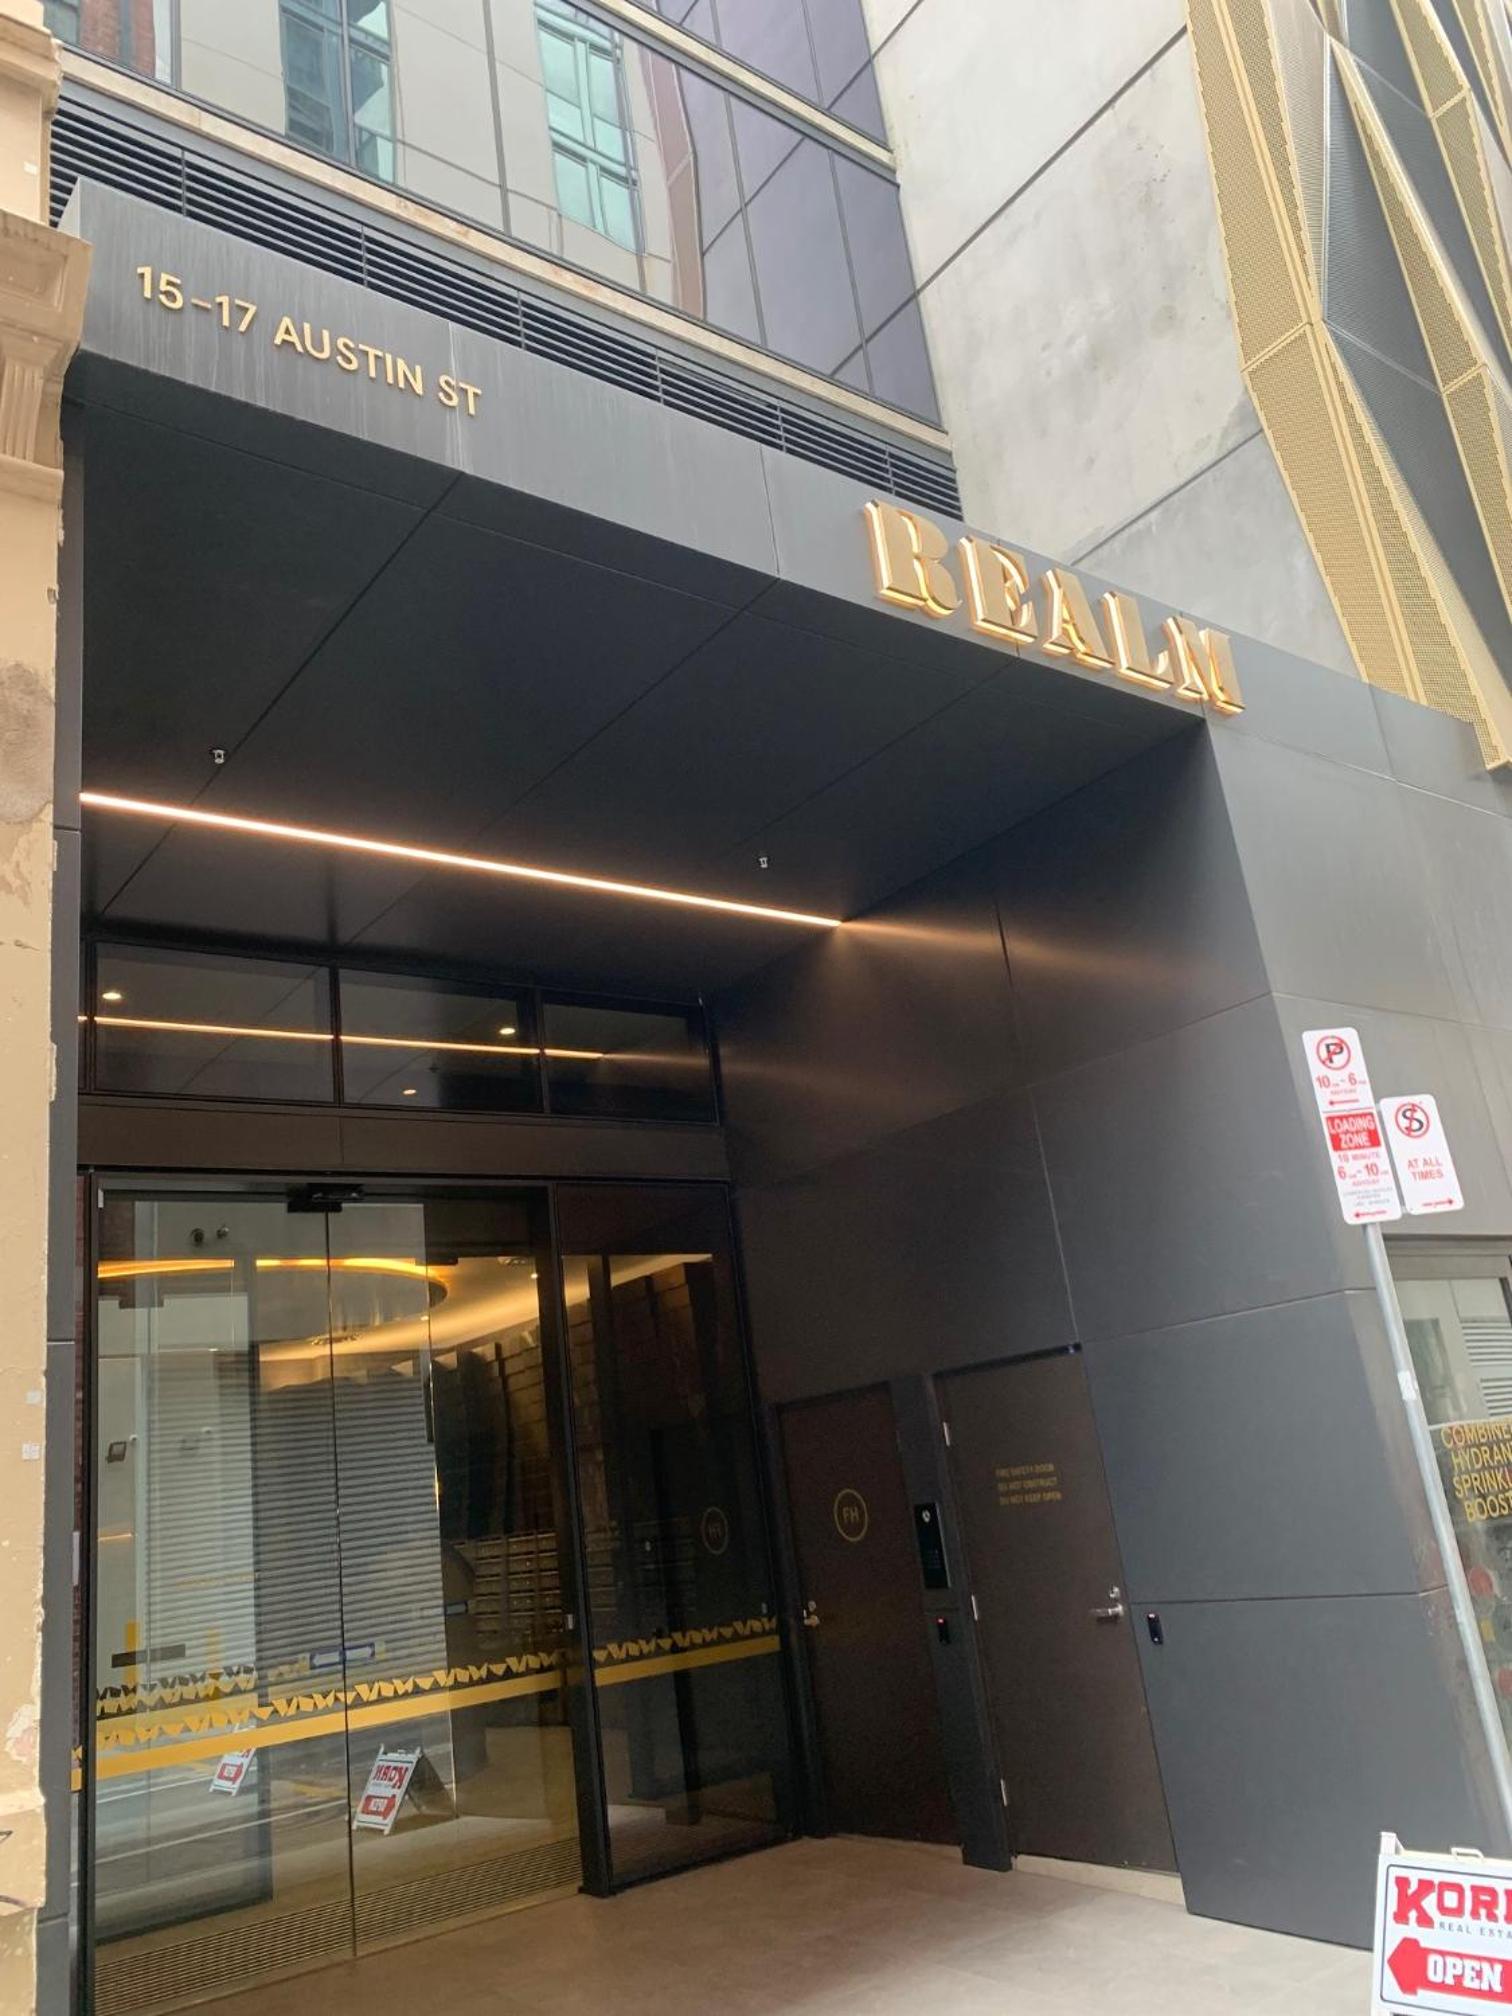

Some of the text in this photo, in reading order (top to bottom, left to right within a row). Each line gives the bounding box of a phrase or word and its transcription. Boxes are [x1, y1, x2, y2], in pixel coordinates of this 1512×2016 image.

[136, 265, 483, 418] 15-17 AUSTIN ST
[863, 498, 1246, 715] REALM
[1328, 1116, 1375, 1134] LOADING
[1338, 1131, 1372, 1149] ZONE
[1407, 1157, 1443, 1169] AT ALL
[1411, 1168, 1444, 1182] TIMES
[1441, 1423, 1512, 1449] COMBINE
[1451, 1442, 1512, 1475] HYDRAN
[1393, 1875, 1512, 1929] KOR
[1438, 1921, 1472, 1936] REAL
[1426, 1953, 1504, 1993] OPEN
